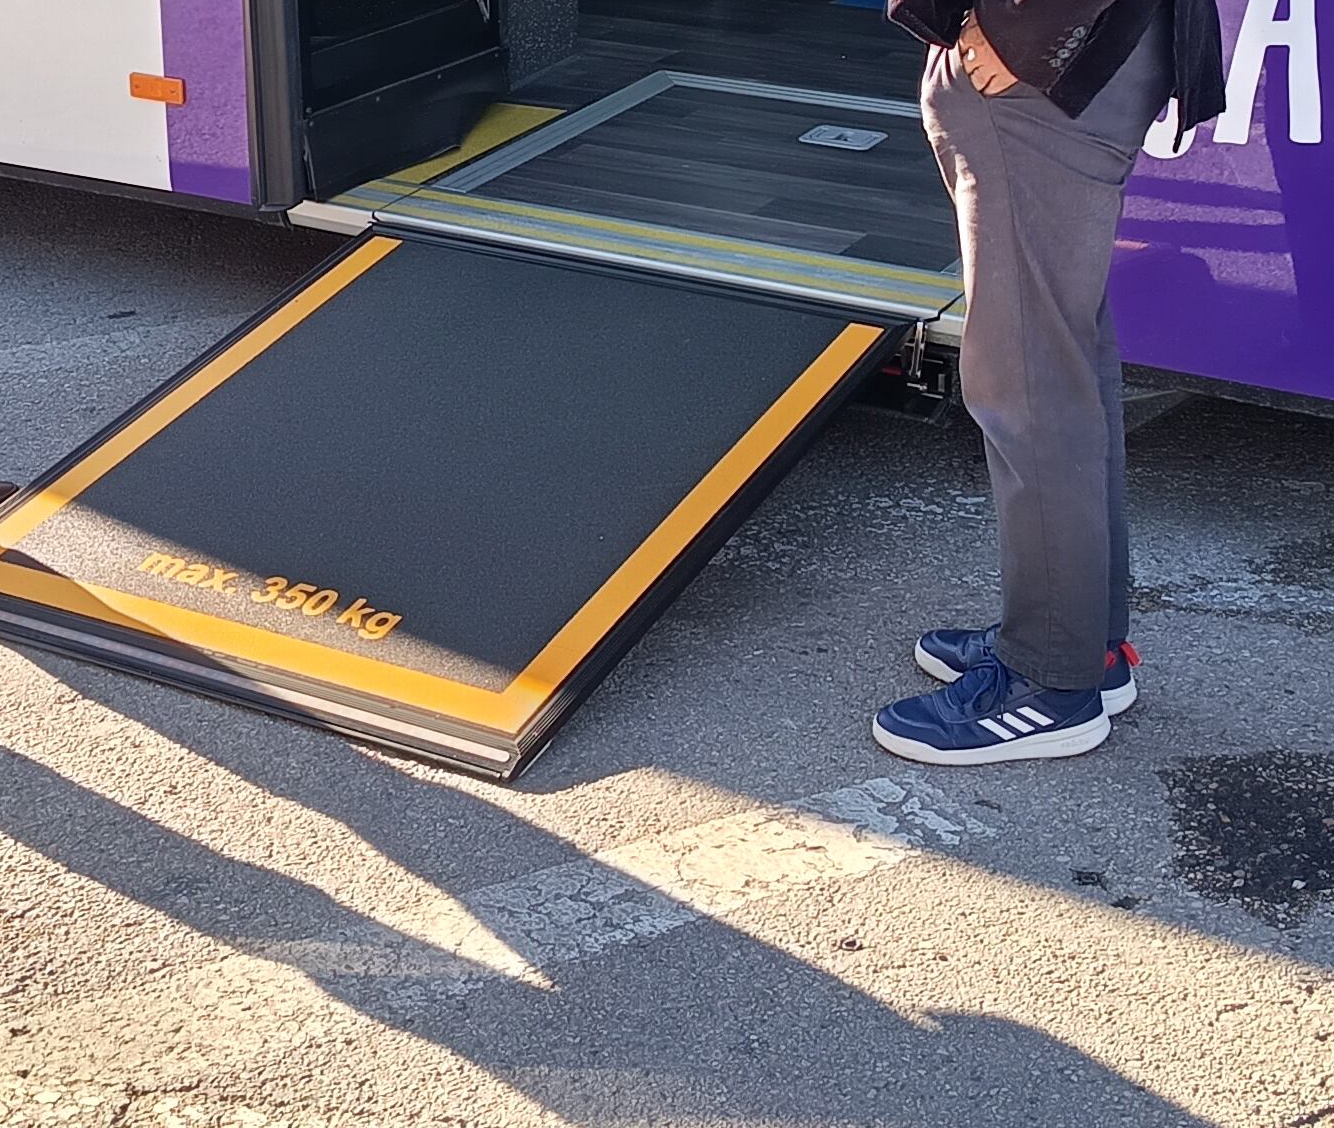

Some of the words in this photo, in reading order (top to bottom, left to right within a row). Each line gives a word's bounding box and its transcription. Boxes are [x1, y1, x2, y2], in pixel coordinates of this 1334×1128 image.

[137, 551, 237, 595] max.
[251, 576, 339, 617] 350
[336, 598, 403, 640] kg
